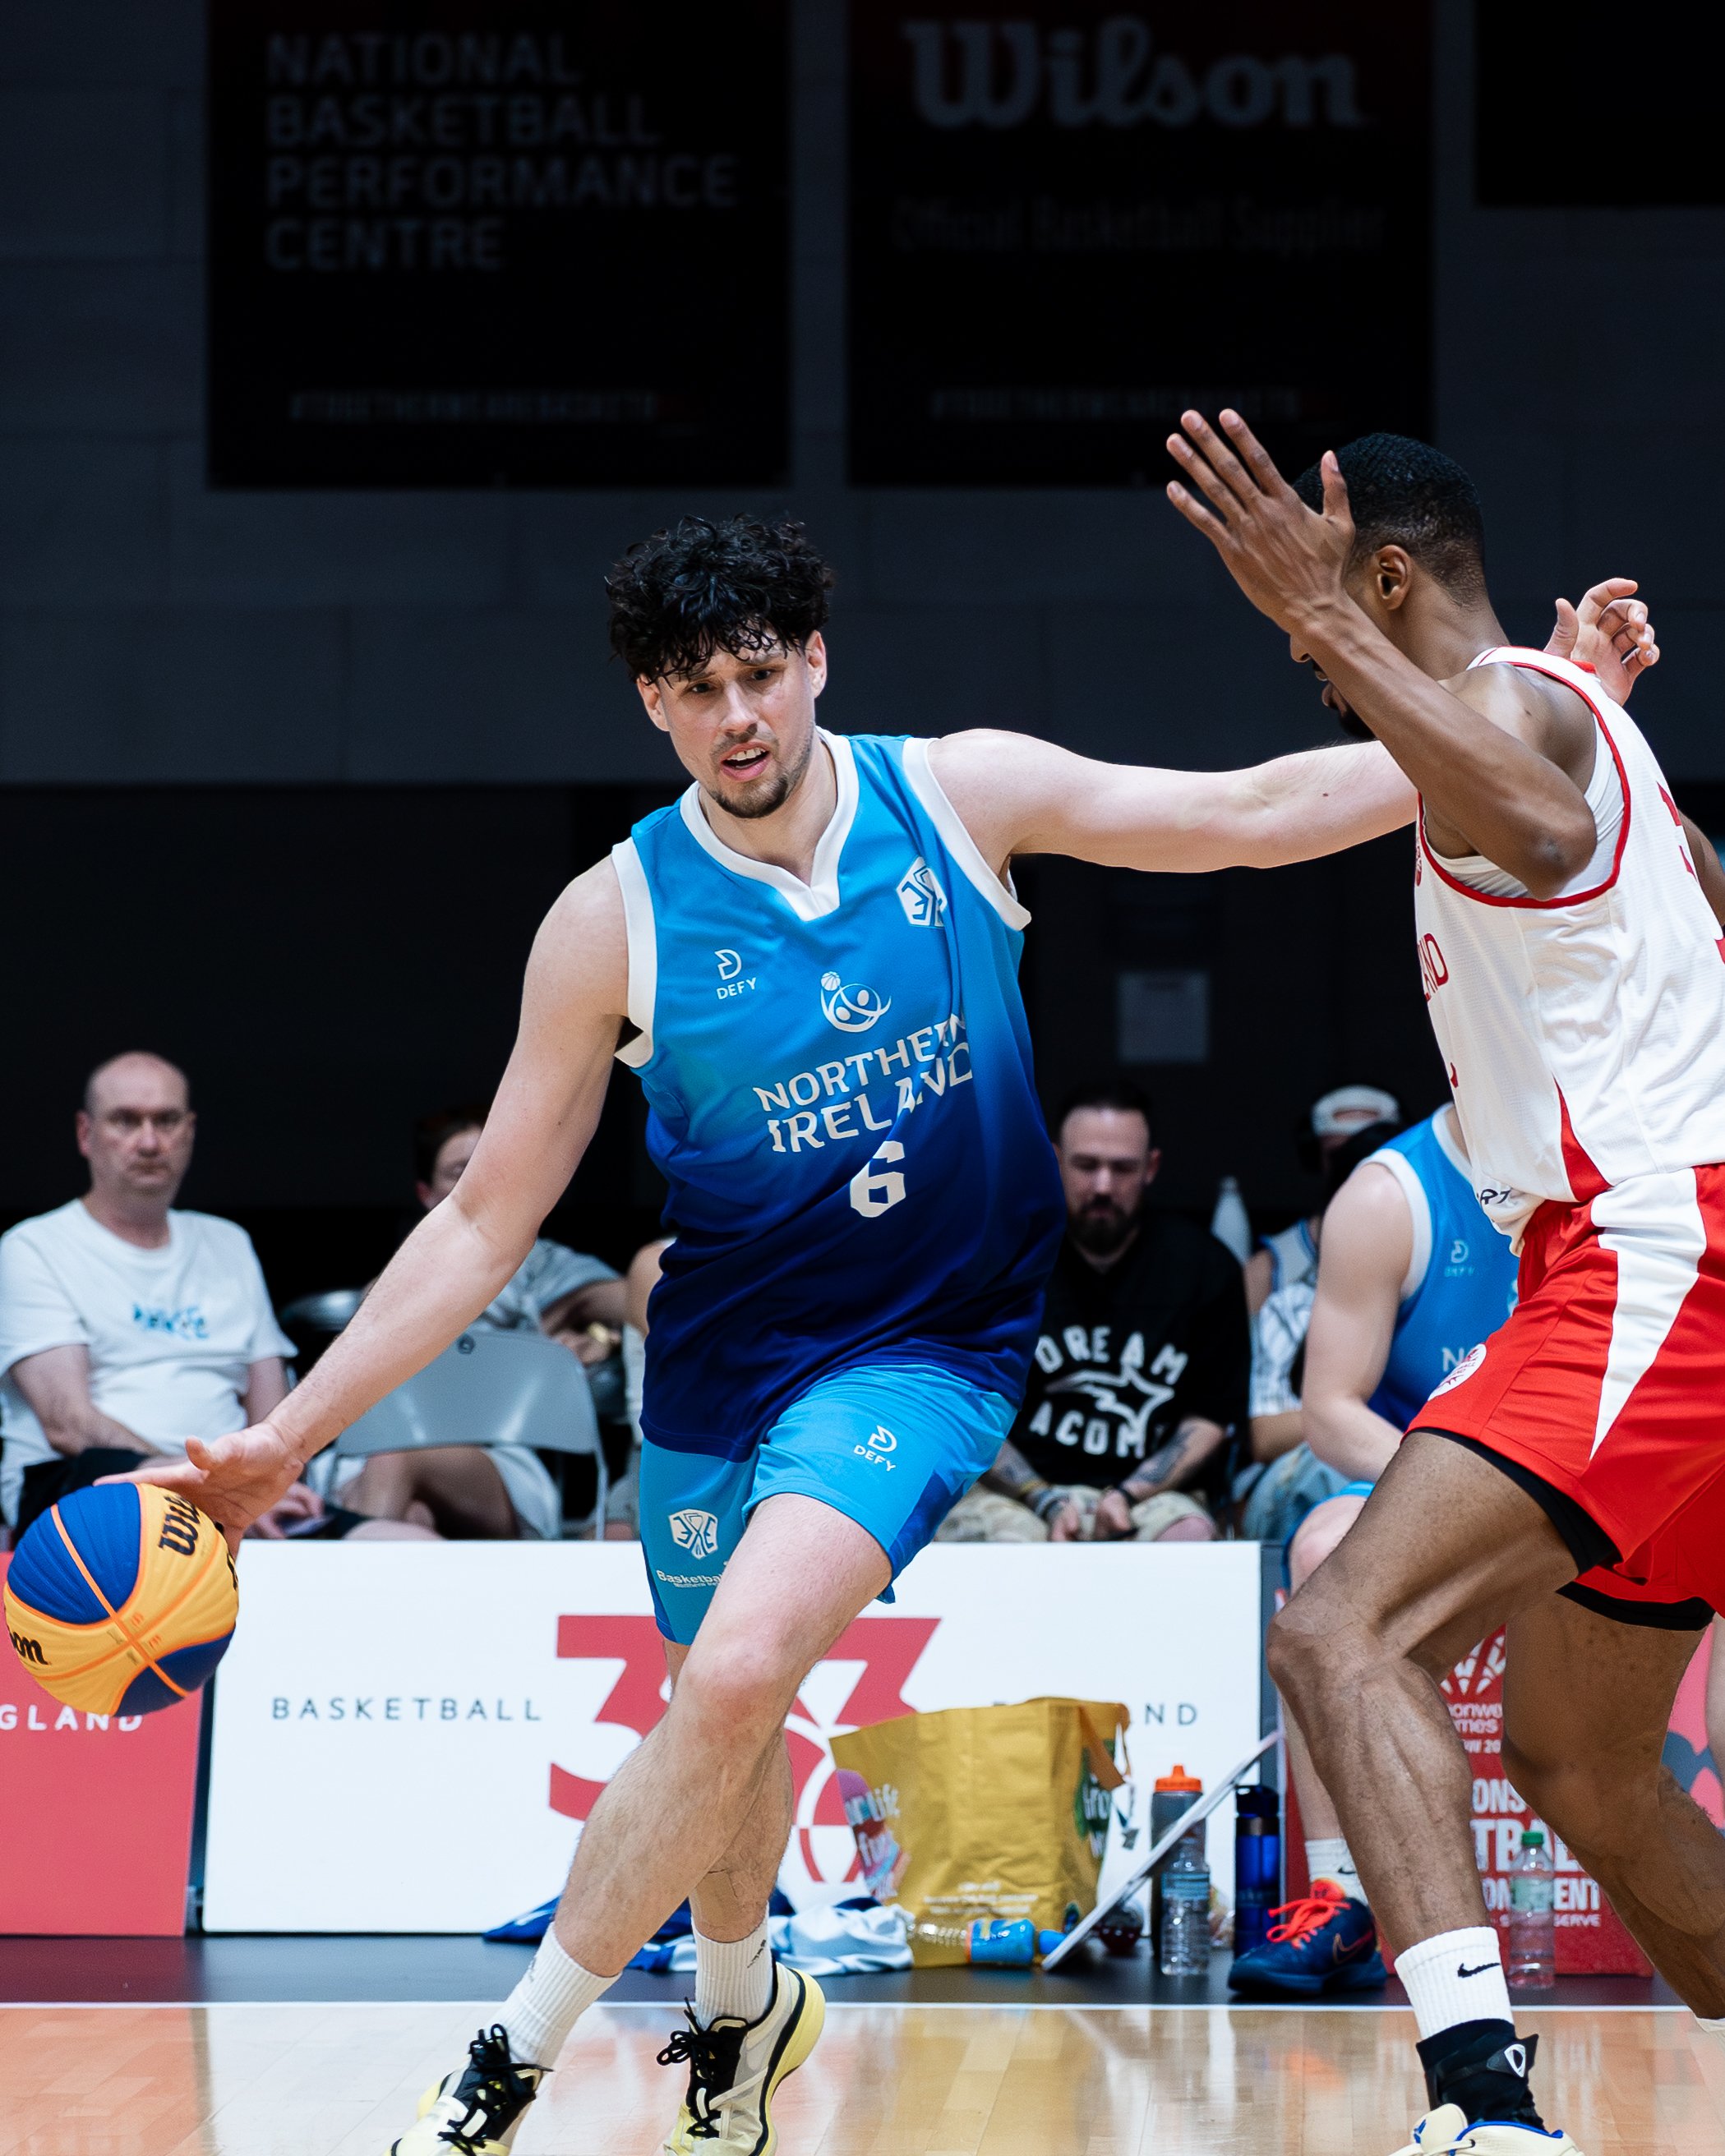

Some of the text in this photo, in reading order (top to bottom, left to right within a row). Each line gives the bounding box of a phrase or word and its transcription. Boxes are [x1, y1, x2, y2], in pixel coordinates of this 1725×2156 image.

[267, 31, 583, 86] NATIONAL
[901, 13, 1368, 129] Wilson
[266, 93, 666, 148] BASKETBALL
[266, 154, 740, 210] PERFORMANCE
[265, 215, 507, 272] CENTRE
[717, 978, 757, 1000] DEFY
[767, 1042, 973, 1153] IRELAND
[850, 1140, 906, 1219] 6
[1035, 1324, 1189, 1386] DREAM
[854, 1444, 897, 1472] DEFY
[0, 1703, 143, 1732] GLAND
[272, 1698, 541, 1721] BASKETBALL
[1472, 1779, 1526, 1813] ONS
[1469, 1818, 1584, 1872] TBAL
[1552, 1913, 1602, 1928] SERVE
